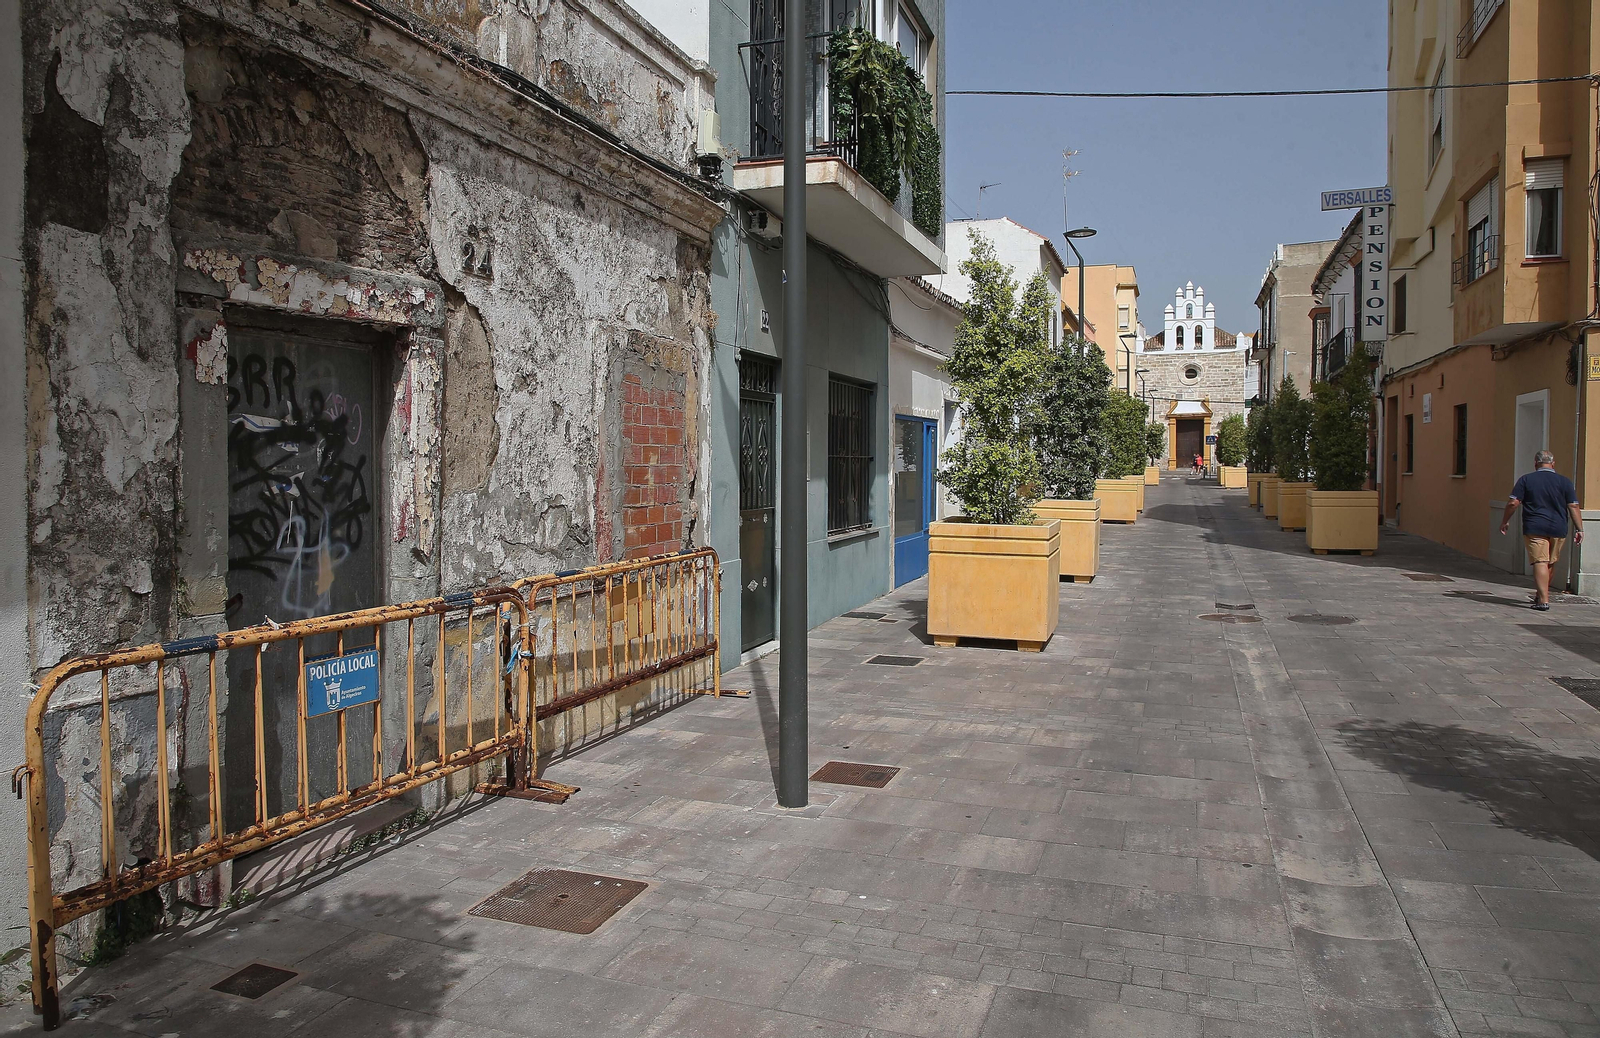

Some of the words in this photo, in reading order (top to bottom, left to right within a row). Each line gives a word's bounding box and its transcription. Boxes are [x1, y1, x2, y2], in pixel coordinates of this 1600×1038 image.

[1324, 188, 1391, 206] VERSALLES
[461, 241, 492, 275] 24
[1366, 206, 1385, 327] PENSION
[309, 659, 347, 681] POLICÍA
[348, 654, 376, 673] LOCAL
